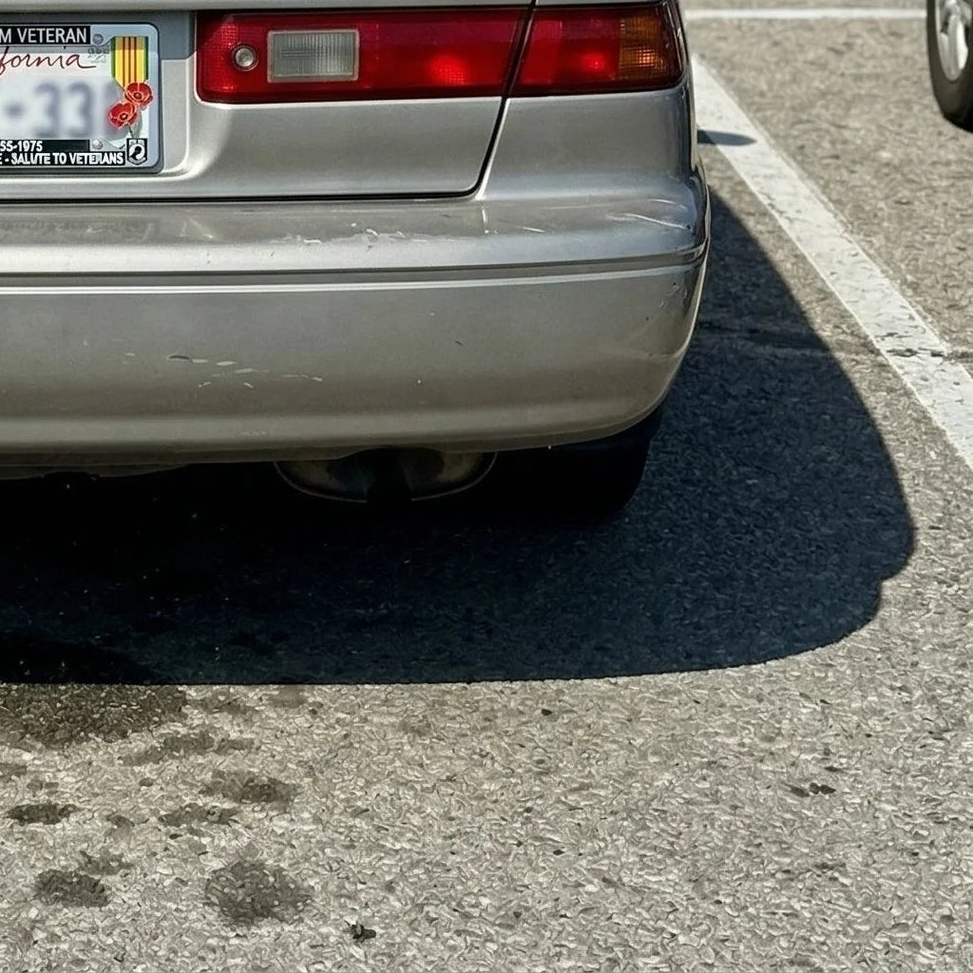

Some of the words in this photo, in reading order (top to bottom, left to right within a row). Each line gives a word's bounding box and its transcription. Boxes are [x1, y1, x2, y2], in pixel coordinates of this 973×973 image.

[17, 28, 87, 44] VETERAN
[11, 153, 51, 165] SALUTE
[52, 153, 67, 165] TO
[69, 153, 124, 165] VETERANS
